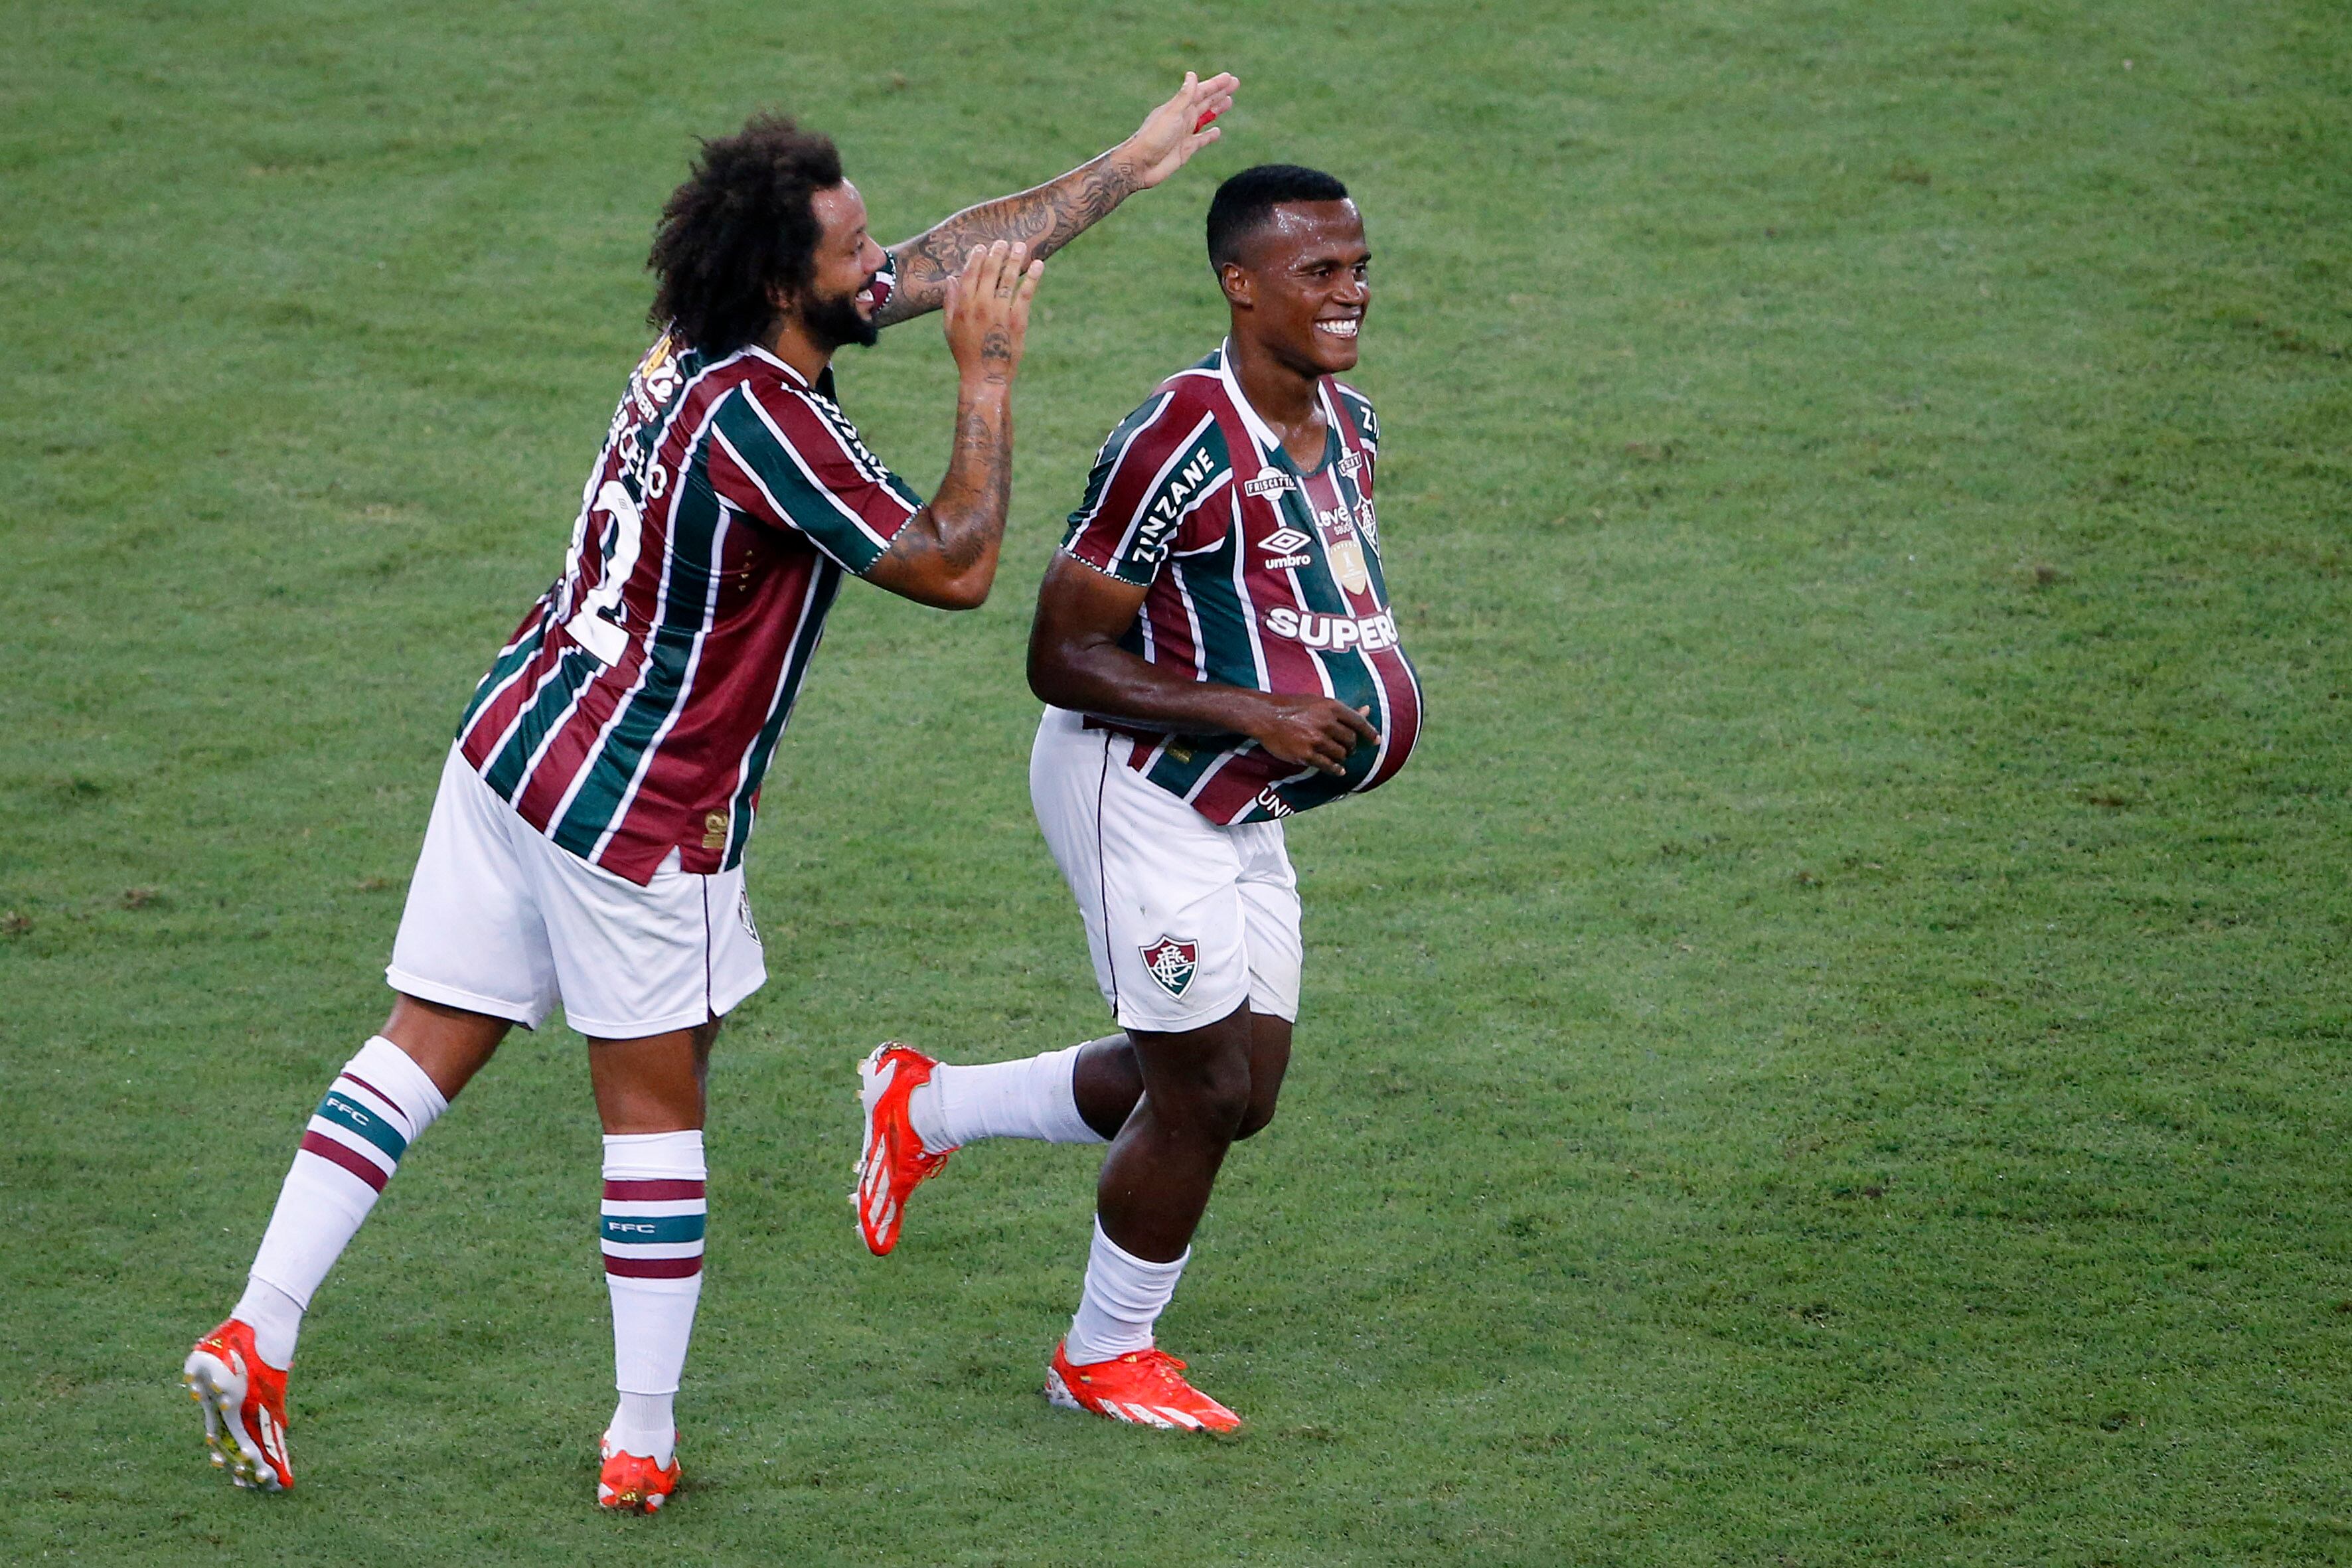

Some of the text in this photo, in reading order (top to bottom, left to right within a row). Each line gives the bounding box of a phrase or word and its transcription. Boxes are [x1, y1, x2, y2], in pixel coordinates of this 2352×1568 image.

[1132, 447, 1215, 563] ZINZANE
[1265, 554, 1311, 570] umbro
[1266, 606, 1398, 649] SUPER
[1258, 787, 1294, 818] UNI
[326, 1097, 370, 1127] FFC
[608, 1221, 655, 1234] FFC
